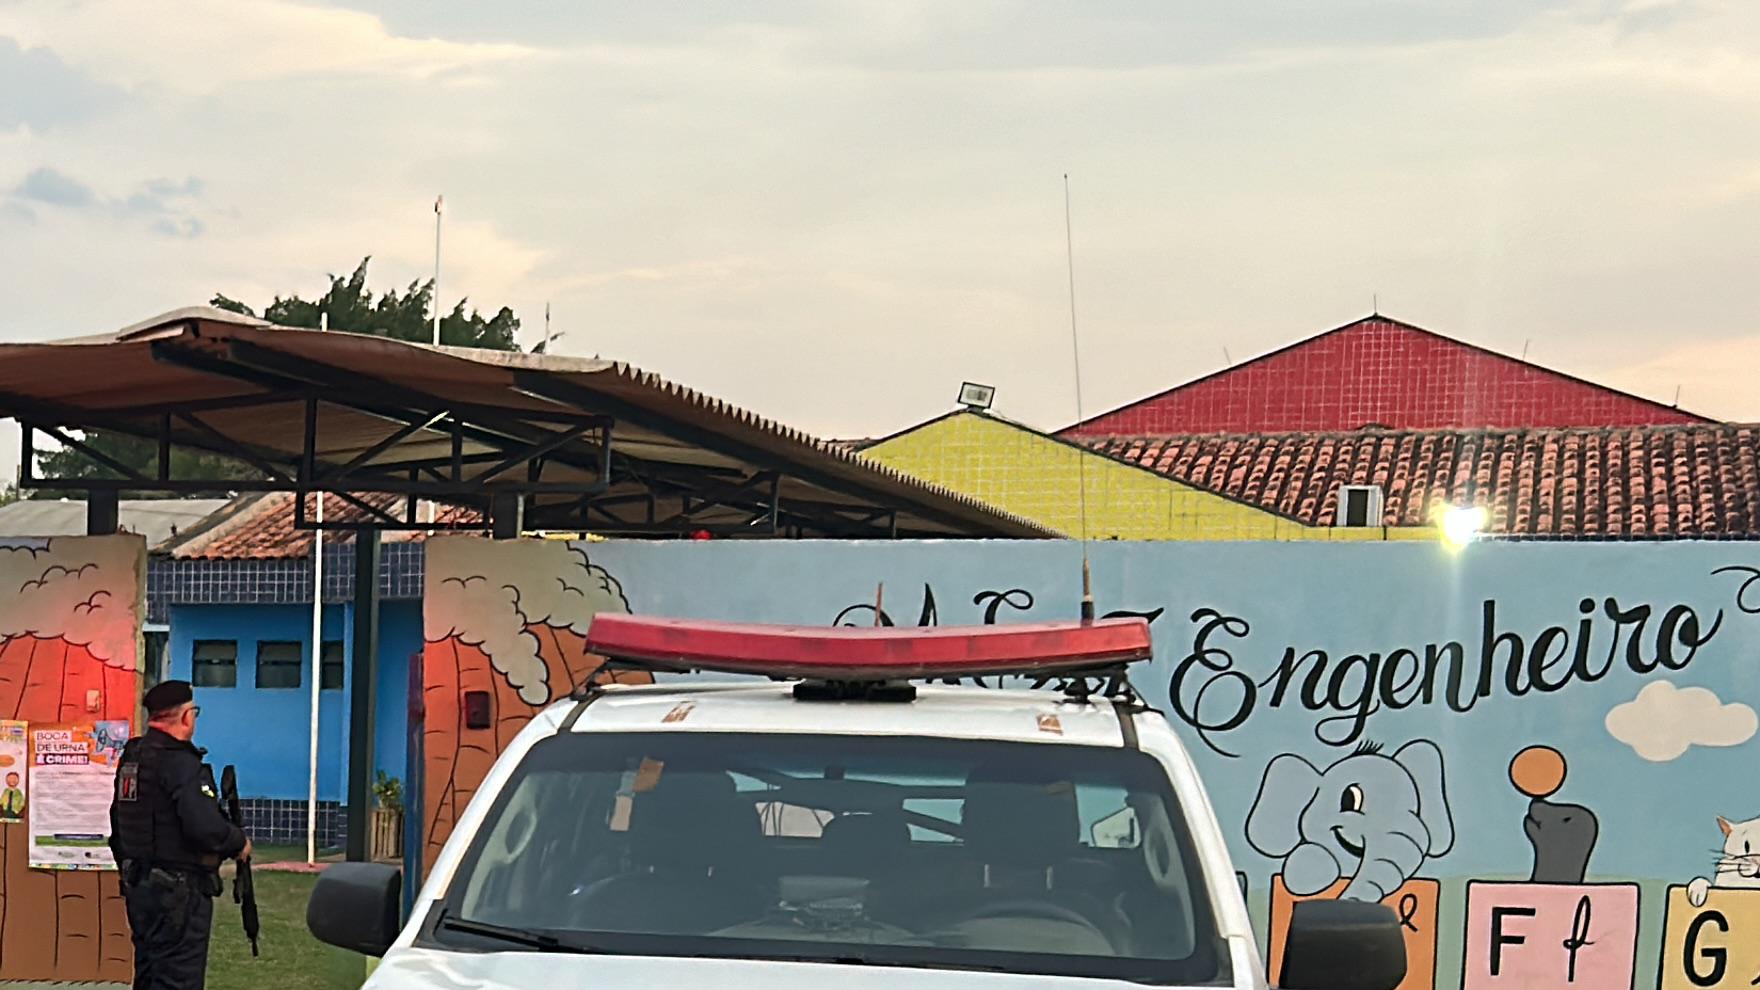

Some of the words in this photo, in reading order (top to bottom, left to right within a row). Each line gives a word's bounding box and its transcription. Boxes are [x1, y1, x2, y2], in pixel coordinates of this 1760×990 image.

[1169, 598, 1723, 757] Engenheiro
[37, 732, 68, 740] BOCA
[37, 743, 52, 752] DE
[1489, 907, 1536, 976] F
[1682, 910, 1730, 987] G
